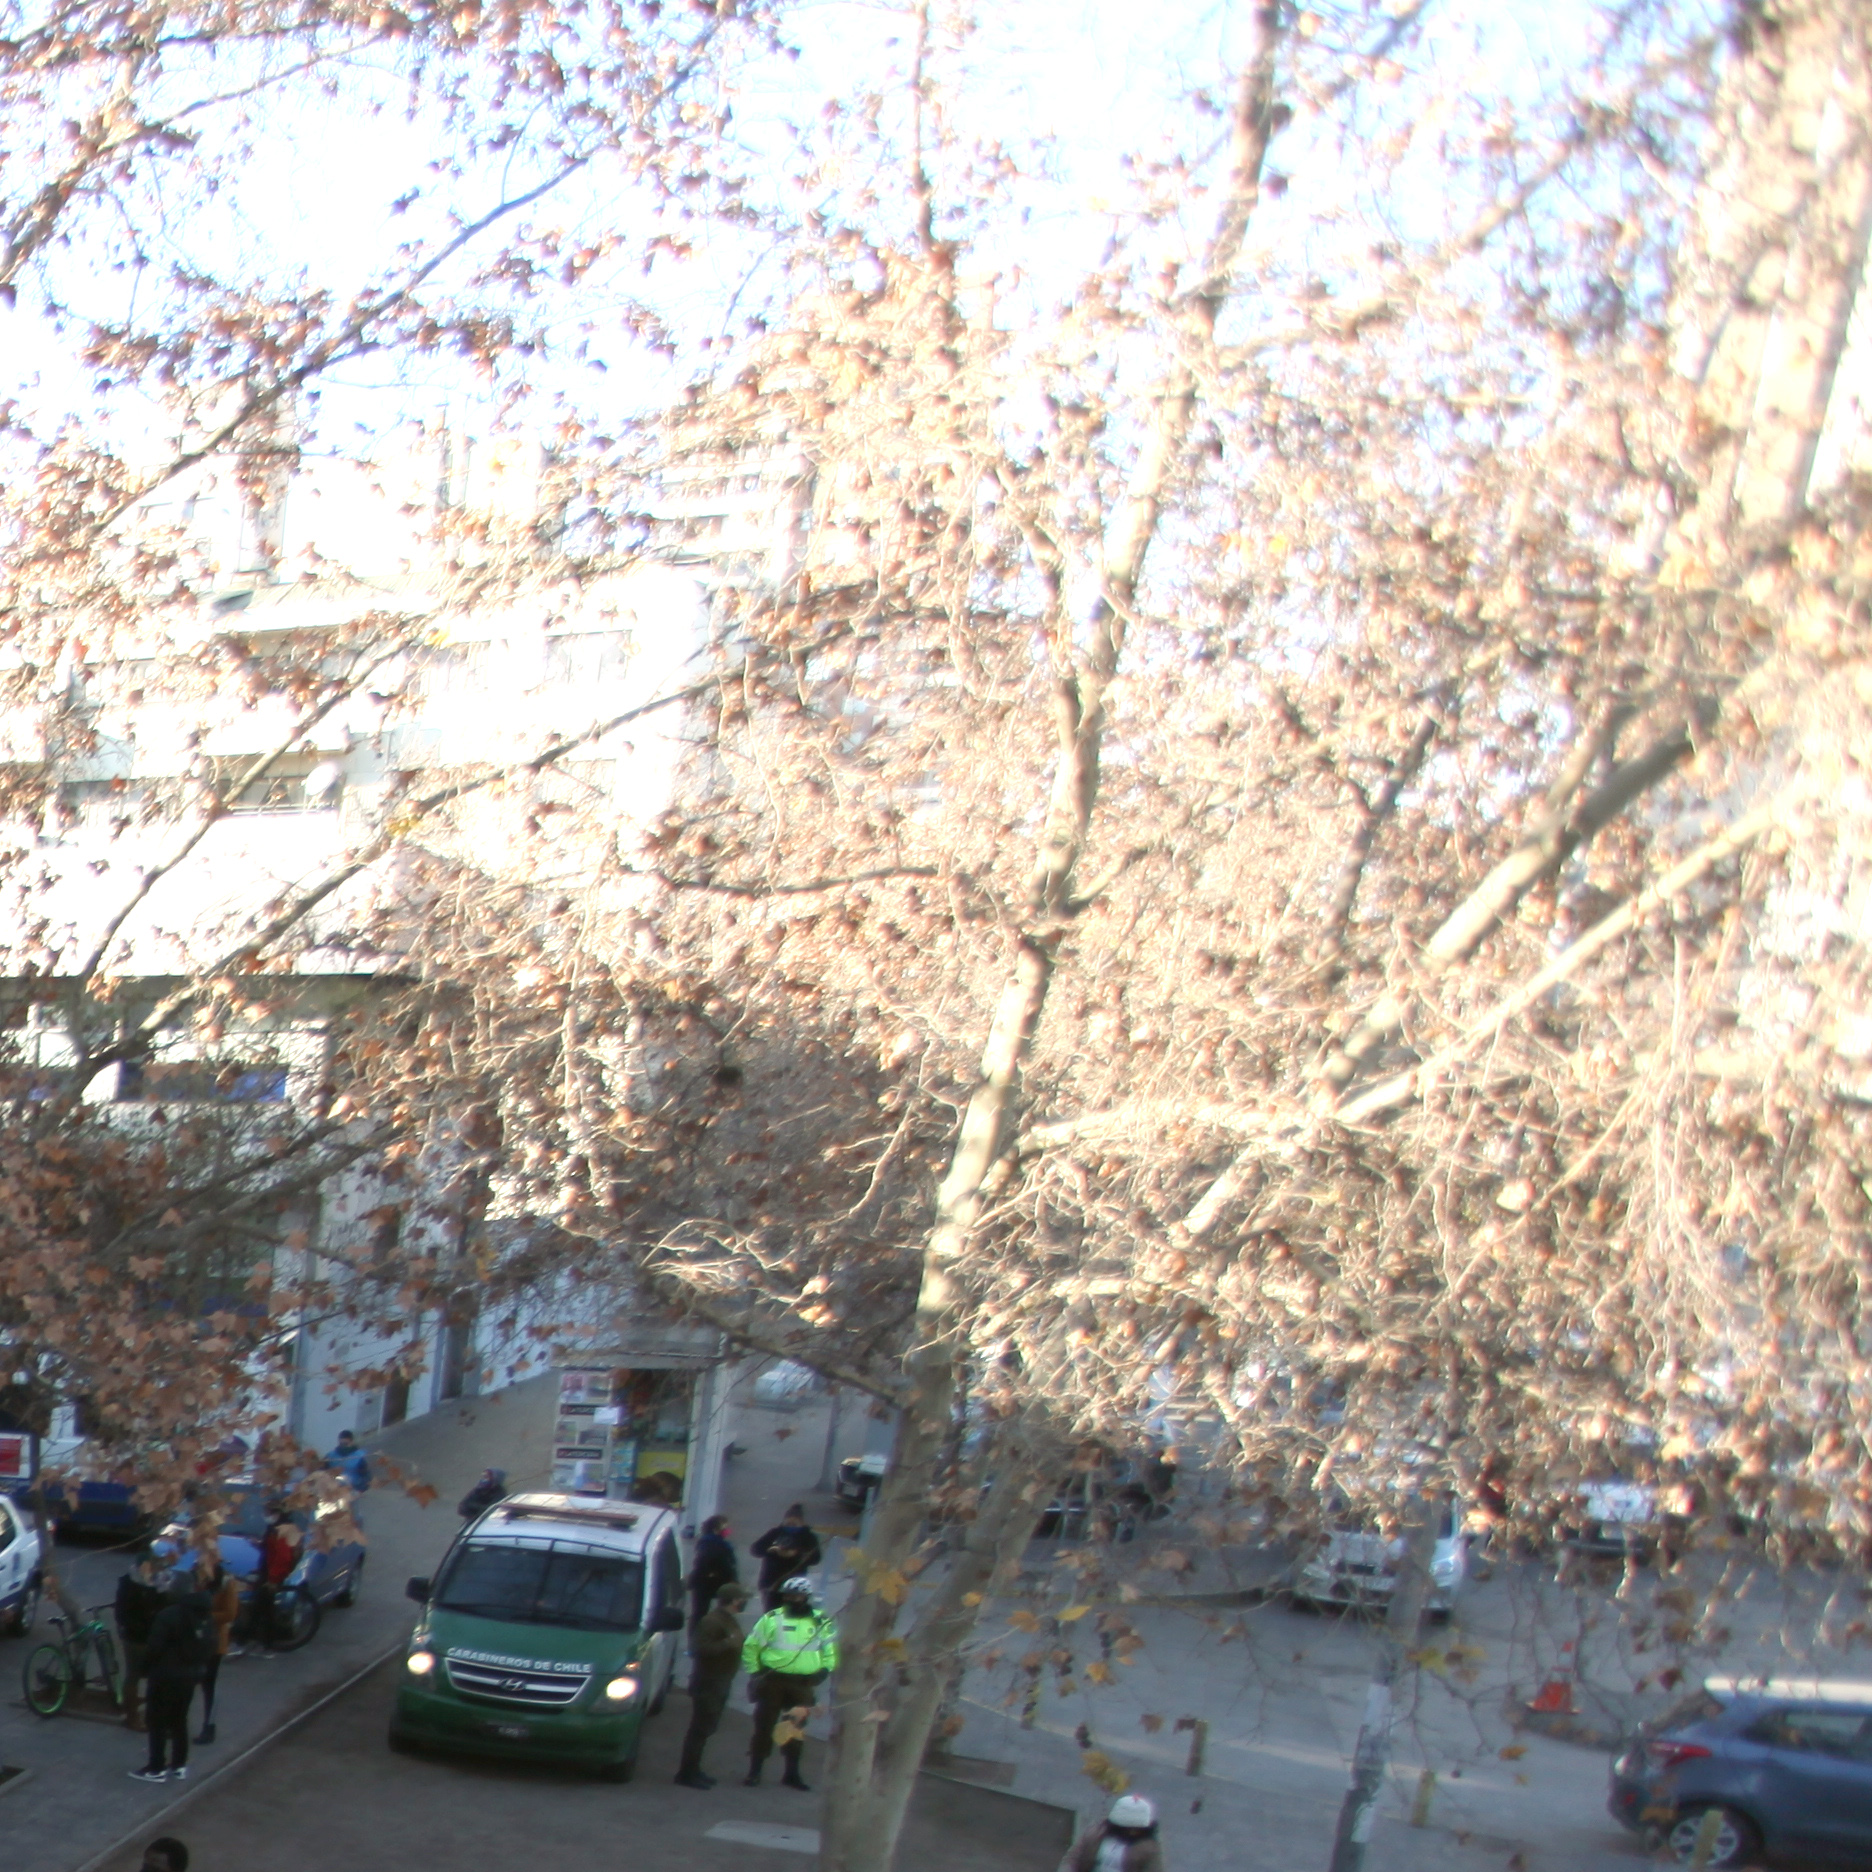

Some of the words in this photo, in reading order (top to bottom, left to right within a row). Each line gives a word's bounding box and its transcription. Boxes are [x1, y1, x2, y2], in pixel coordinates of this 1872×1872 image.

[446, 1647, 531, 1669] CARABINEROS
[534, 1660, 550, 1672] DE
[553, 1662, 592, 1674] CHILE
